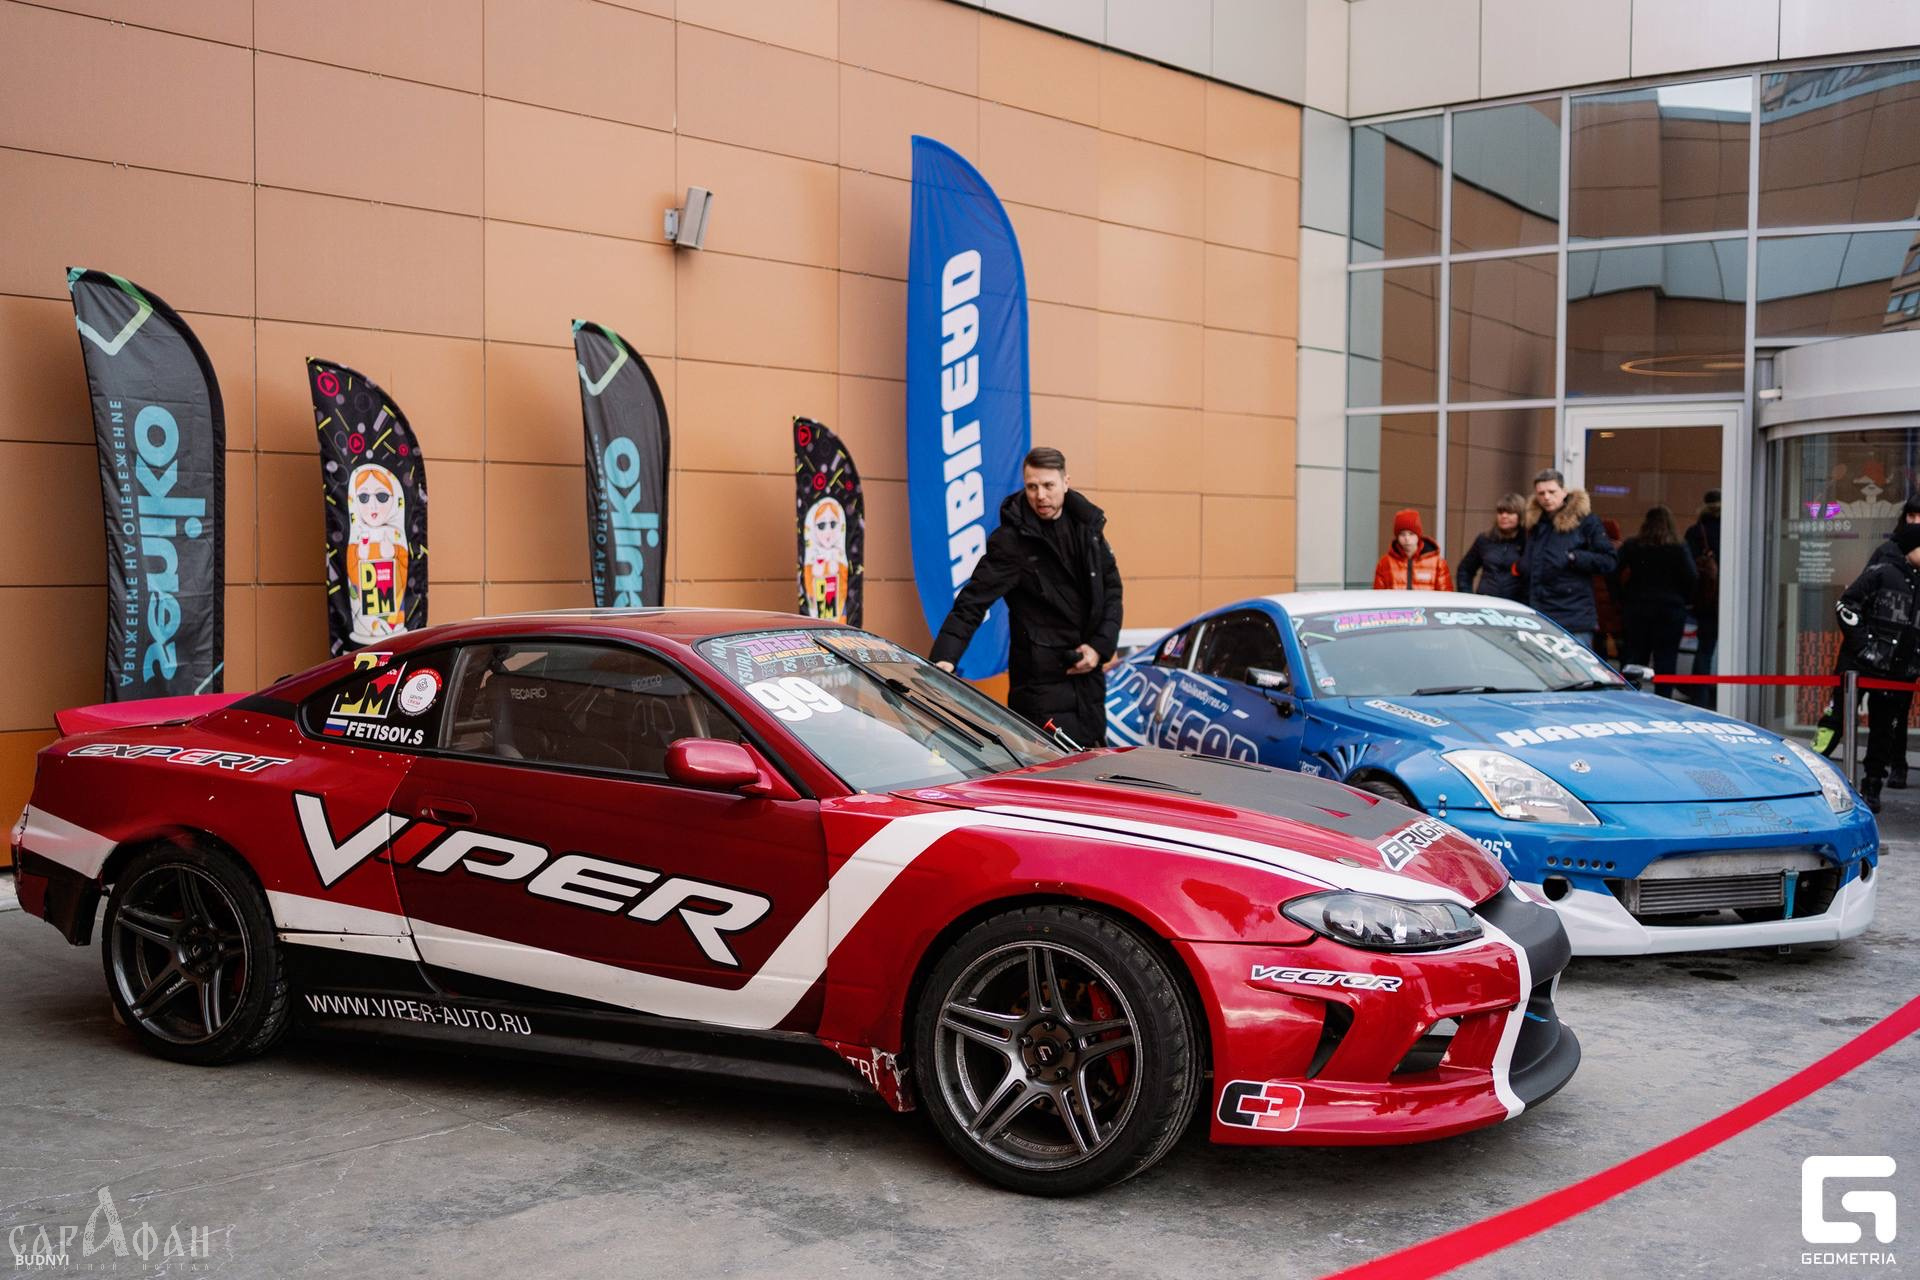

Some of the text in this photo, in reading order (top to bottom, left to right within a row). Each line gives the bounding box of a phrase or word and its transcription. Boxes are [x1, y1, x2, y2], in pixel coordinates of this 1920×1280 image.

[745, 676, 844, 722] 99
[345, 721, 425, 745] FETISOV.S
[1496, 721, 1757, 748] HABILEAD
[1715, 733, 1773, 745] tyres
[67, 743, 293, 773] EXPERT
[294, 791, 774, 968] VIPER
[1251, 965, 1403, 993] VECTOR
[305, 994, 532, 1036] WWW.VIPER-AUTO.RU
